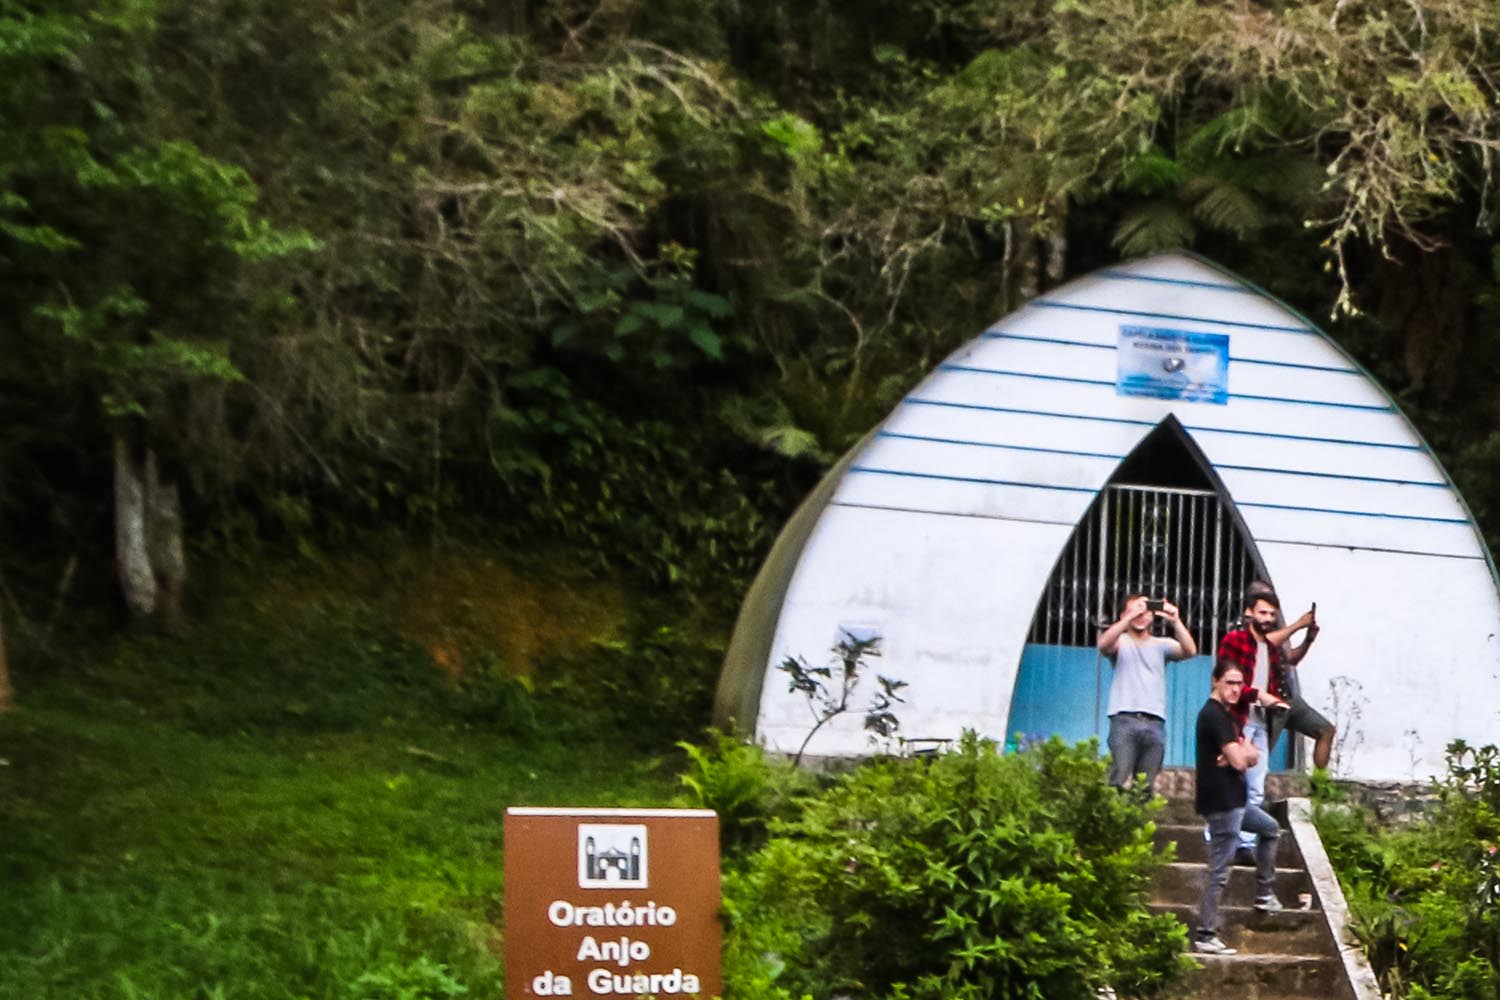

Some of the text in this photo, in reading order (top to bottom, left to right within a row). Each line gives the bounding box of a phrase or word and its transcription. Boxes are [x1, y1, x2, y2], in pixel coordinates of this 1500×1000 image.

[548, 900, 677, 927] Oratório
[577, 936, 651, 967] Anjo
[532, 968, 700, 996] da Guarda
